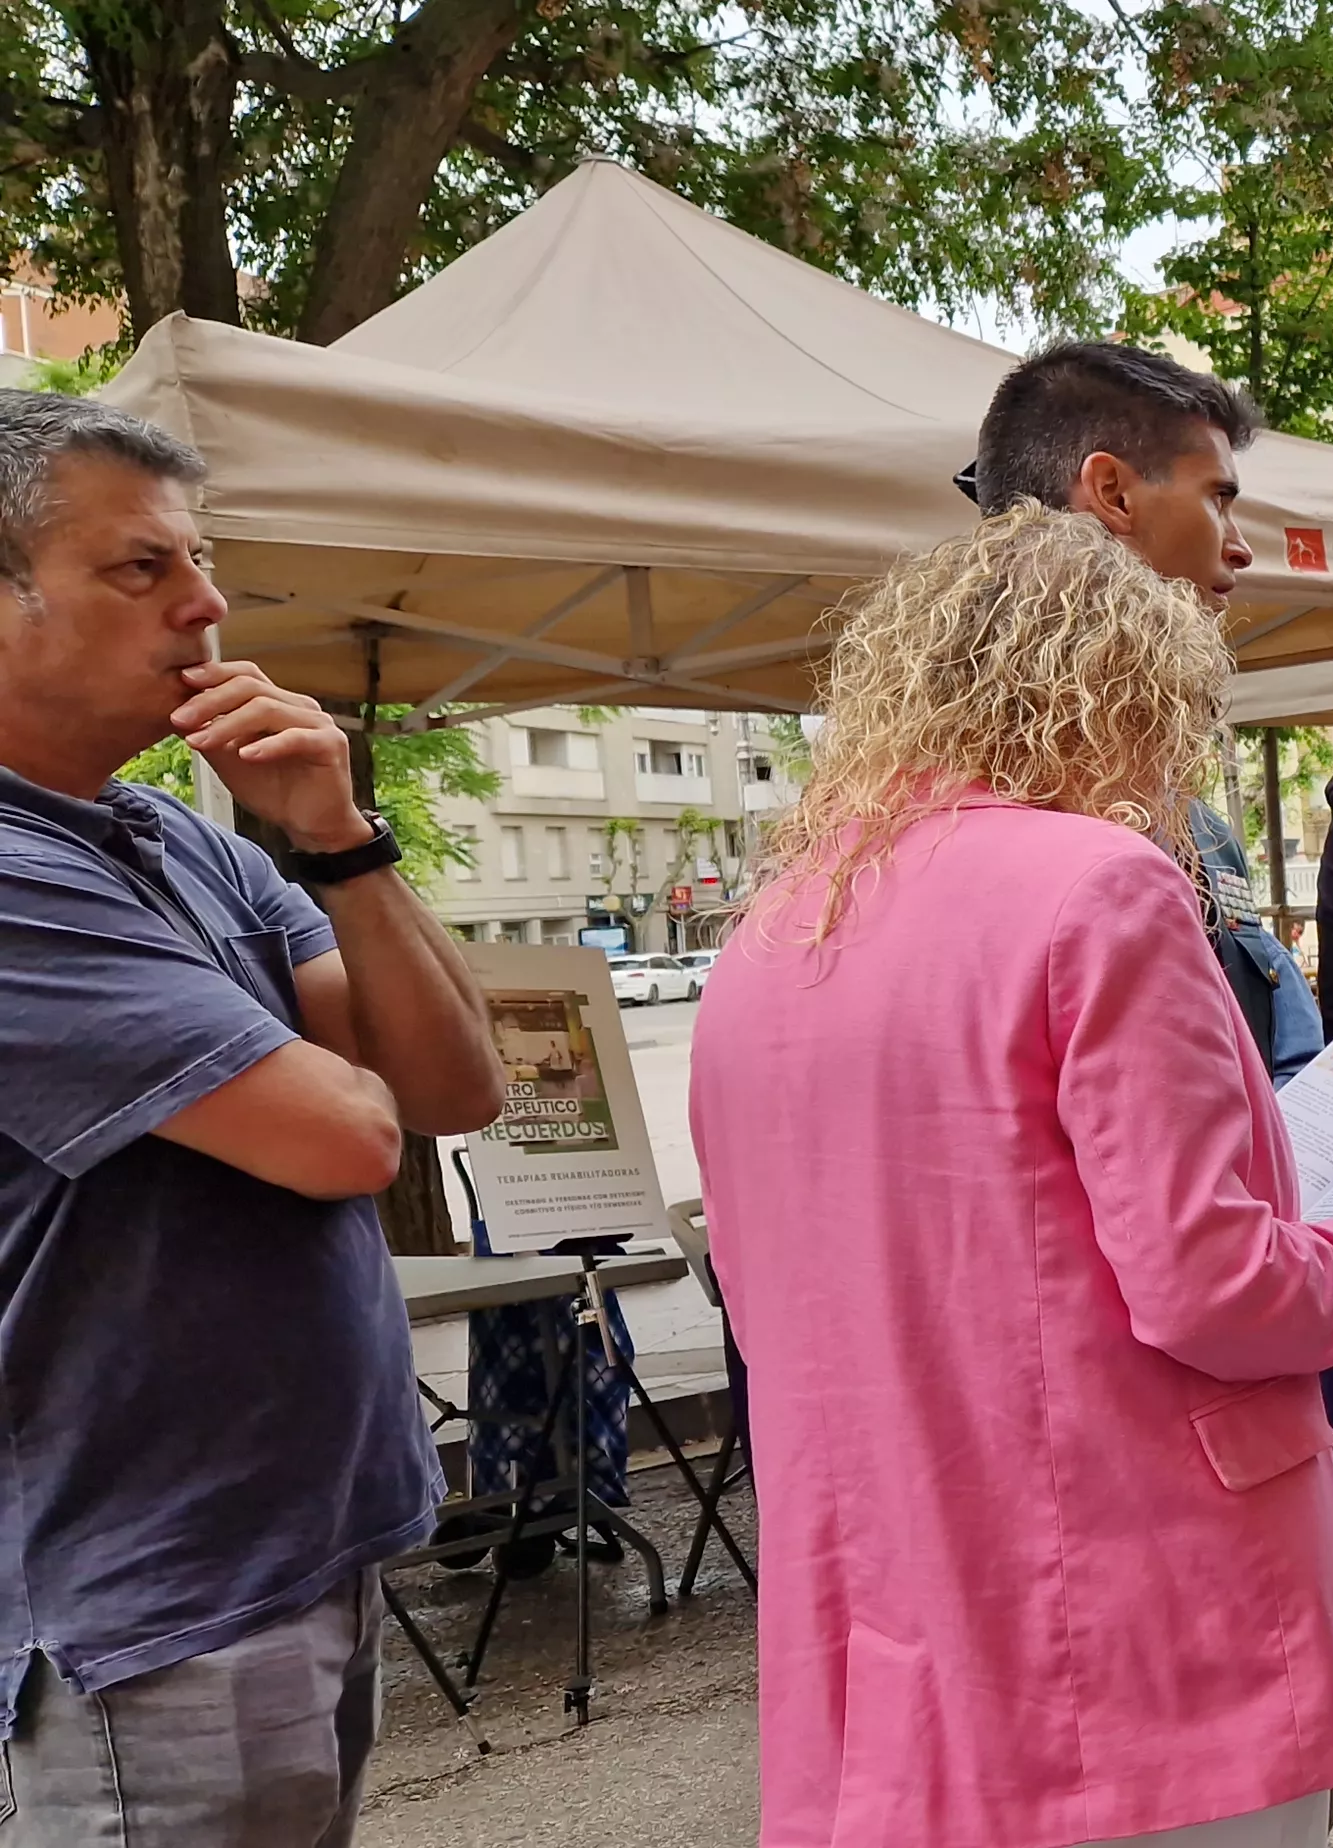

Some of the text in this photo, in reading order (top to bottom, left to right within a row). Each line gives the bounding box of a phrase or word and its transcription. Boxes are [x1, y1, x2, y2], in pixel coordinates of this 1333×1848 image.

[506, 1083, 533, 1097] TRO
[481, 1121, 605, 1142] RECUERDOS
[497, 1168, 641, 1185] TERAPIAS REHABILITADORAS
